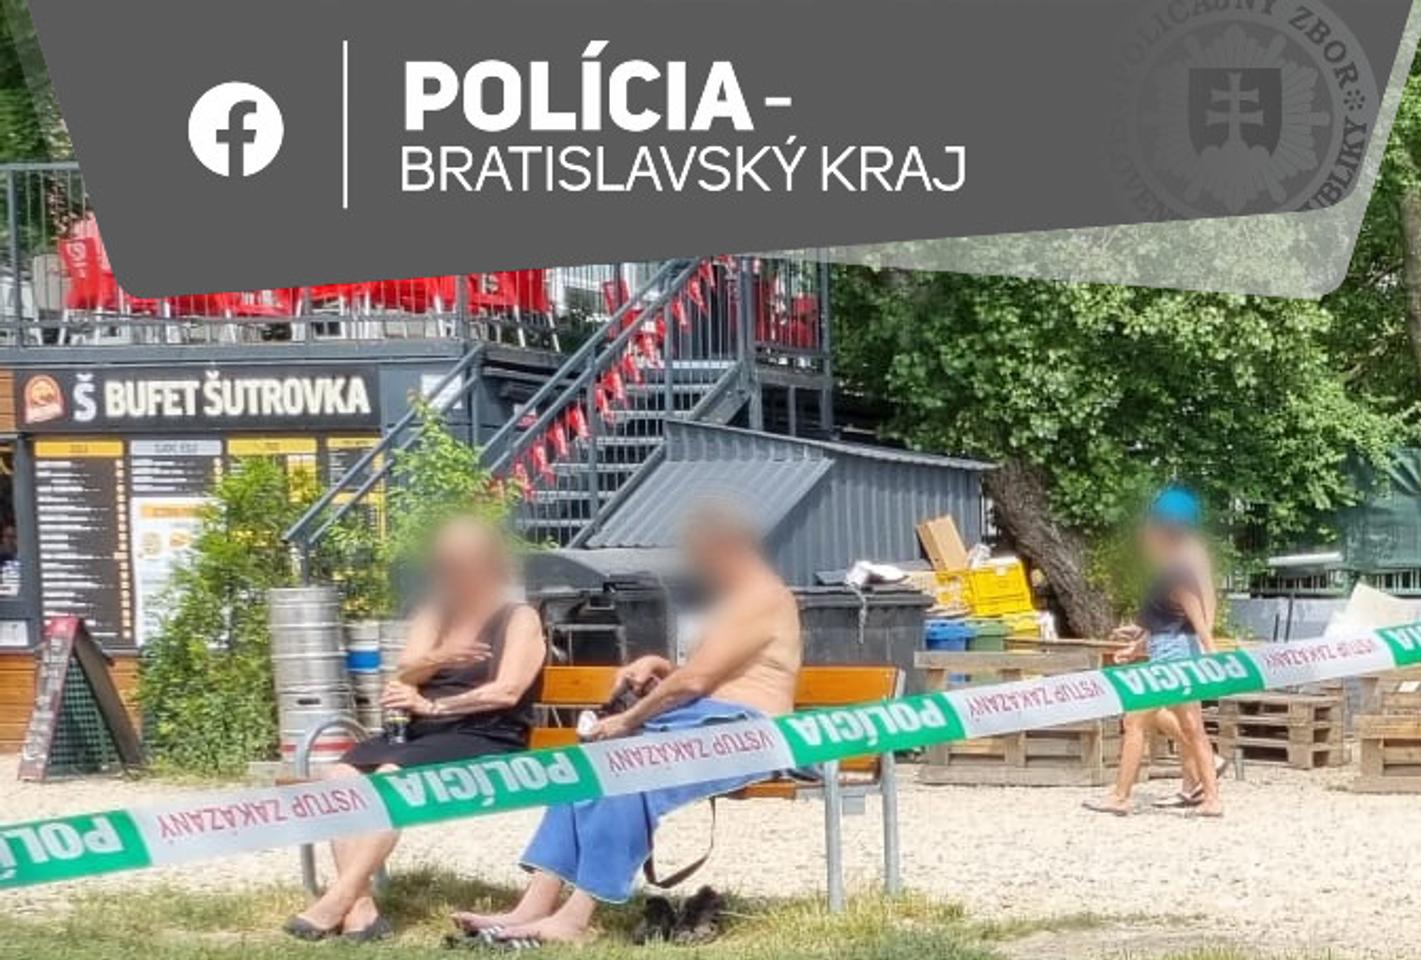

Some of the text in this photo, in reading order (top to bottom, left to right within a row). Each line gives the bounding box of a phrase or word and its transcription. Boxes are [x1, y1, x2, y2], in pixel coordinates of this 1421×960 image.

[104, 380, 200, 417] BUFET
[203, 370, 371, 417] ŠUTROVKA
[1119, 651, 1248, 697] POLÍCIA
[712, 729, 775, 757] VSTUP
[788, 698, 948, 746] POLÍCIA
[291, 788, 368, 819] VSTUP
[387, 756, 580, 807] POLÍCIA
[156, 799, 288, 845] ZAKÁZANÝ
